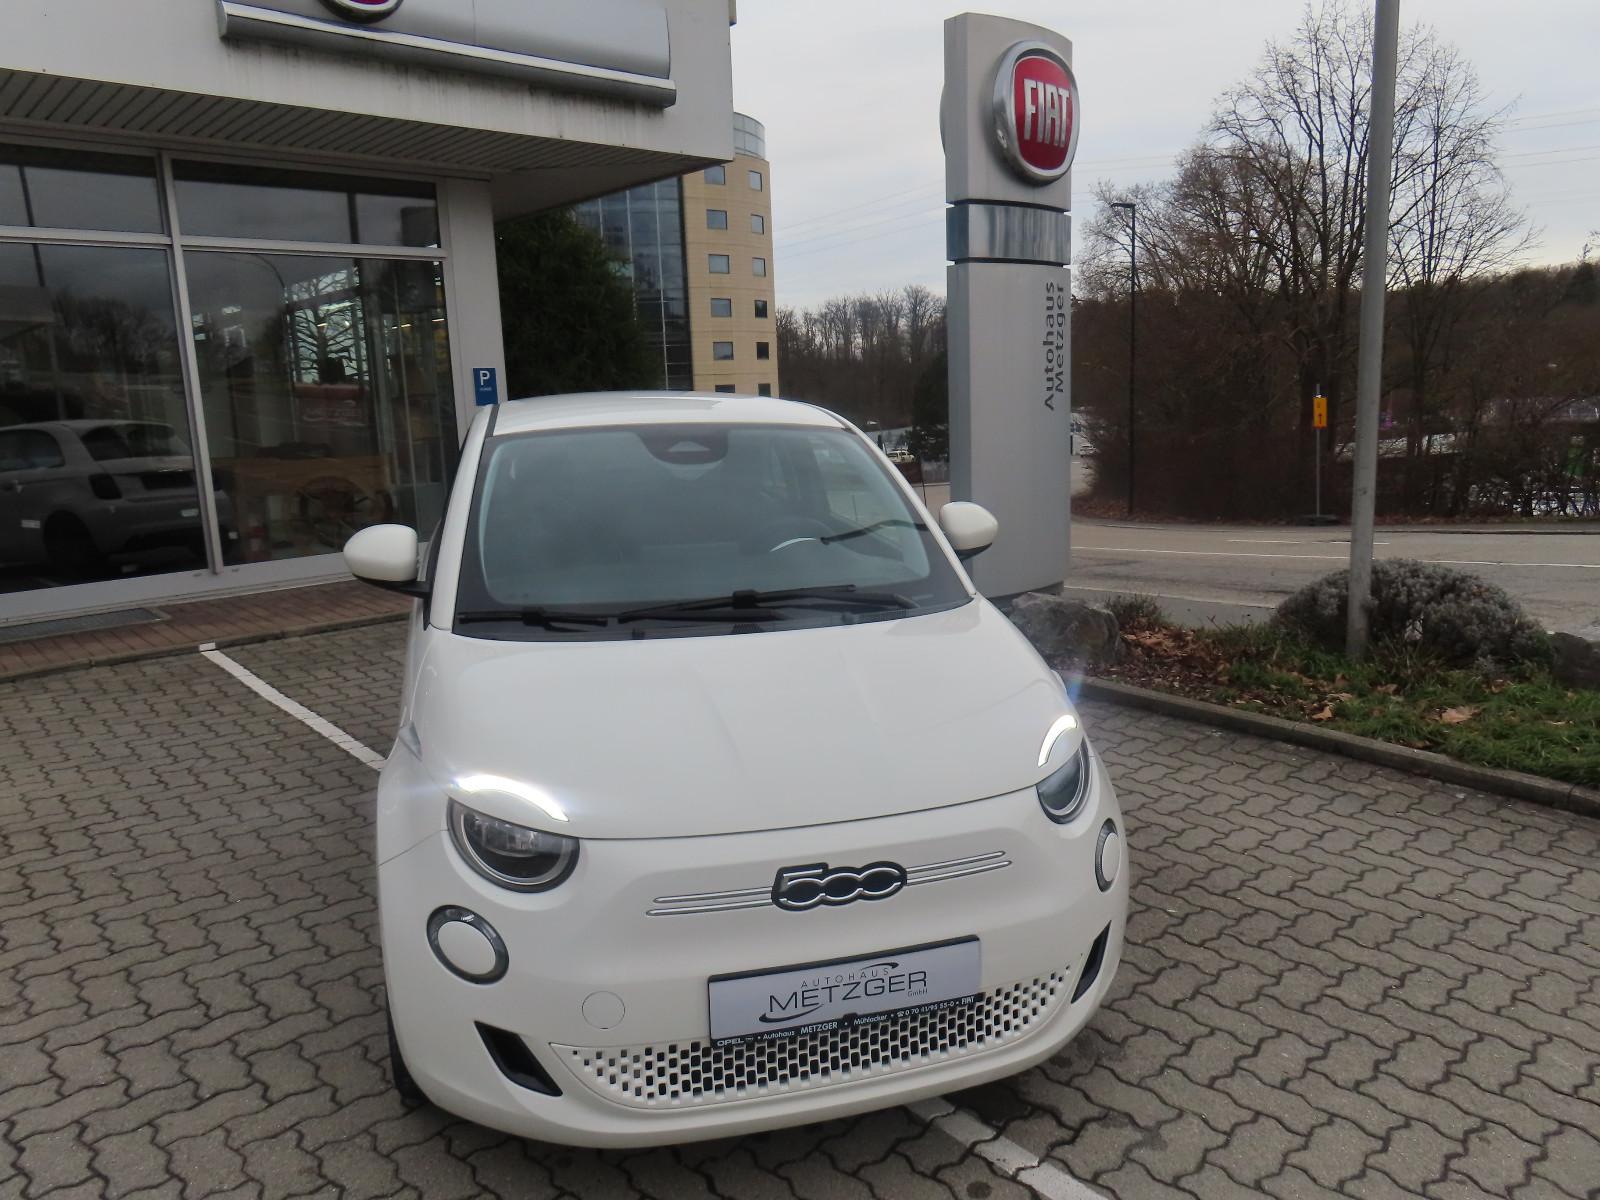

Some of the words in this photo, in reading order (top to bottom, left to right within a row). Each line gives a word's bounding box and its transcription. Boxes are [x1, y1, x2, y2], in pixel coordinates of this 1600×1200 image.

[1023, 78, 1070, 148] FIAT
[1043, 281, 1055, 411] Autohaus
[1055, 283, 1066, 393] Metzger
[479, 370, 490, 386] P
[771, 861, 907, 911] 500
[769, 970, 927, 1013] METZGER
[800, 967, 890, 989] AUTOHAUS
[907, 988, 928, 998] GmbH
[716, 1037, 745, 1047] OPEL
[762, 1030, 795, 1040] Autohaus
[800, 1021, 838, 1035] METZGER
[961, 996, 975, 1006] FIAT
